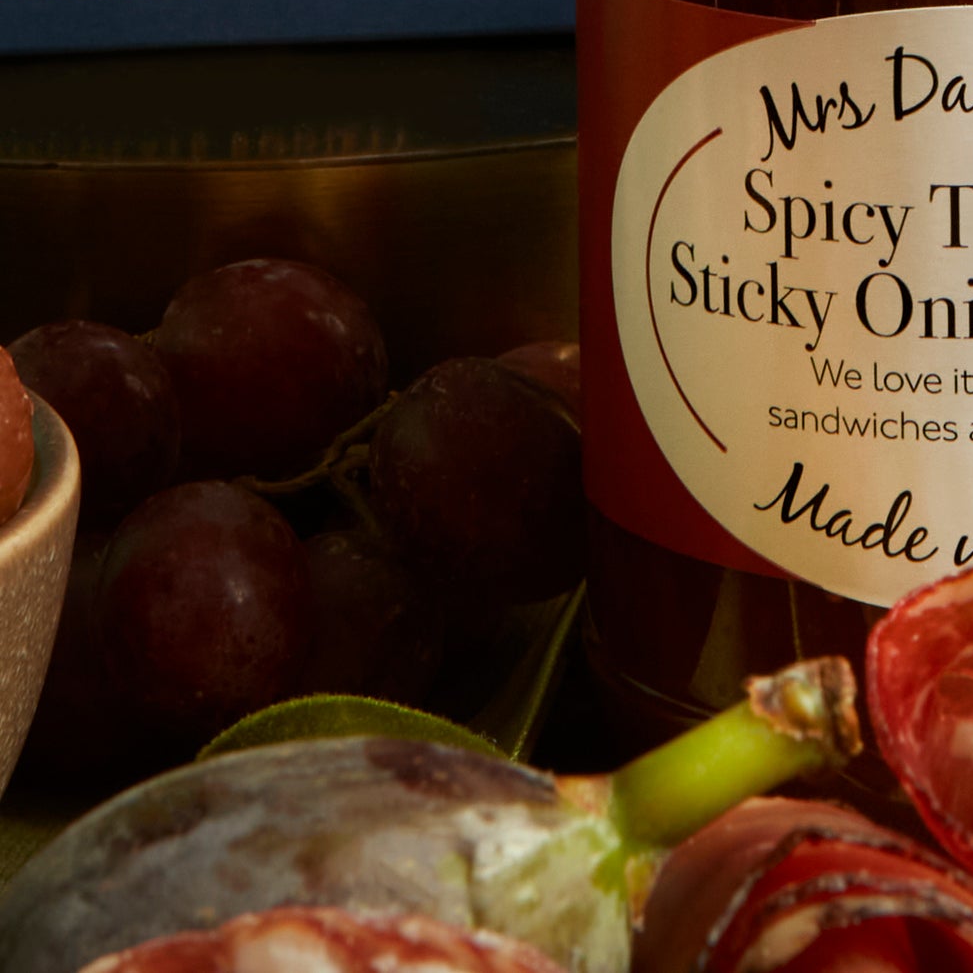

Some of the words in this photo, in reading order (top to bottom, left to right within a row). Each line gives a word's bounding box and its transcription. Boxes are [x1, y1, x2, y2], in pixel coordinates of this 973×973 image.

[760, 81, 876, 162] Mrs
[744, 168, 914, 268] Spicy
[670, 240, 837, 352] Sticky
[810, 356, 863, 390] We
[873, 362, 943, 394] love
[768, 404, 958, 442] sandwiches
[753, 461, 939, 563] Made
